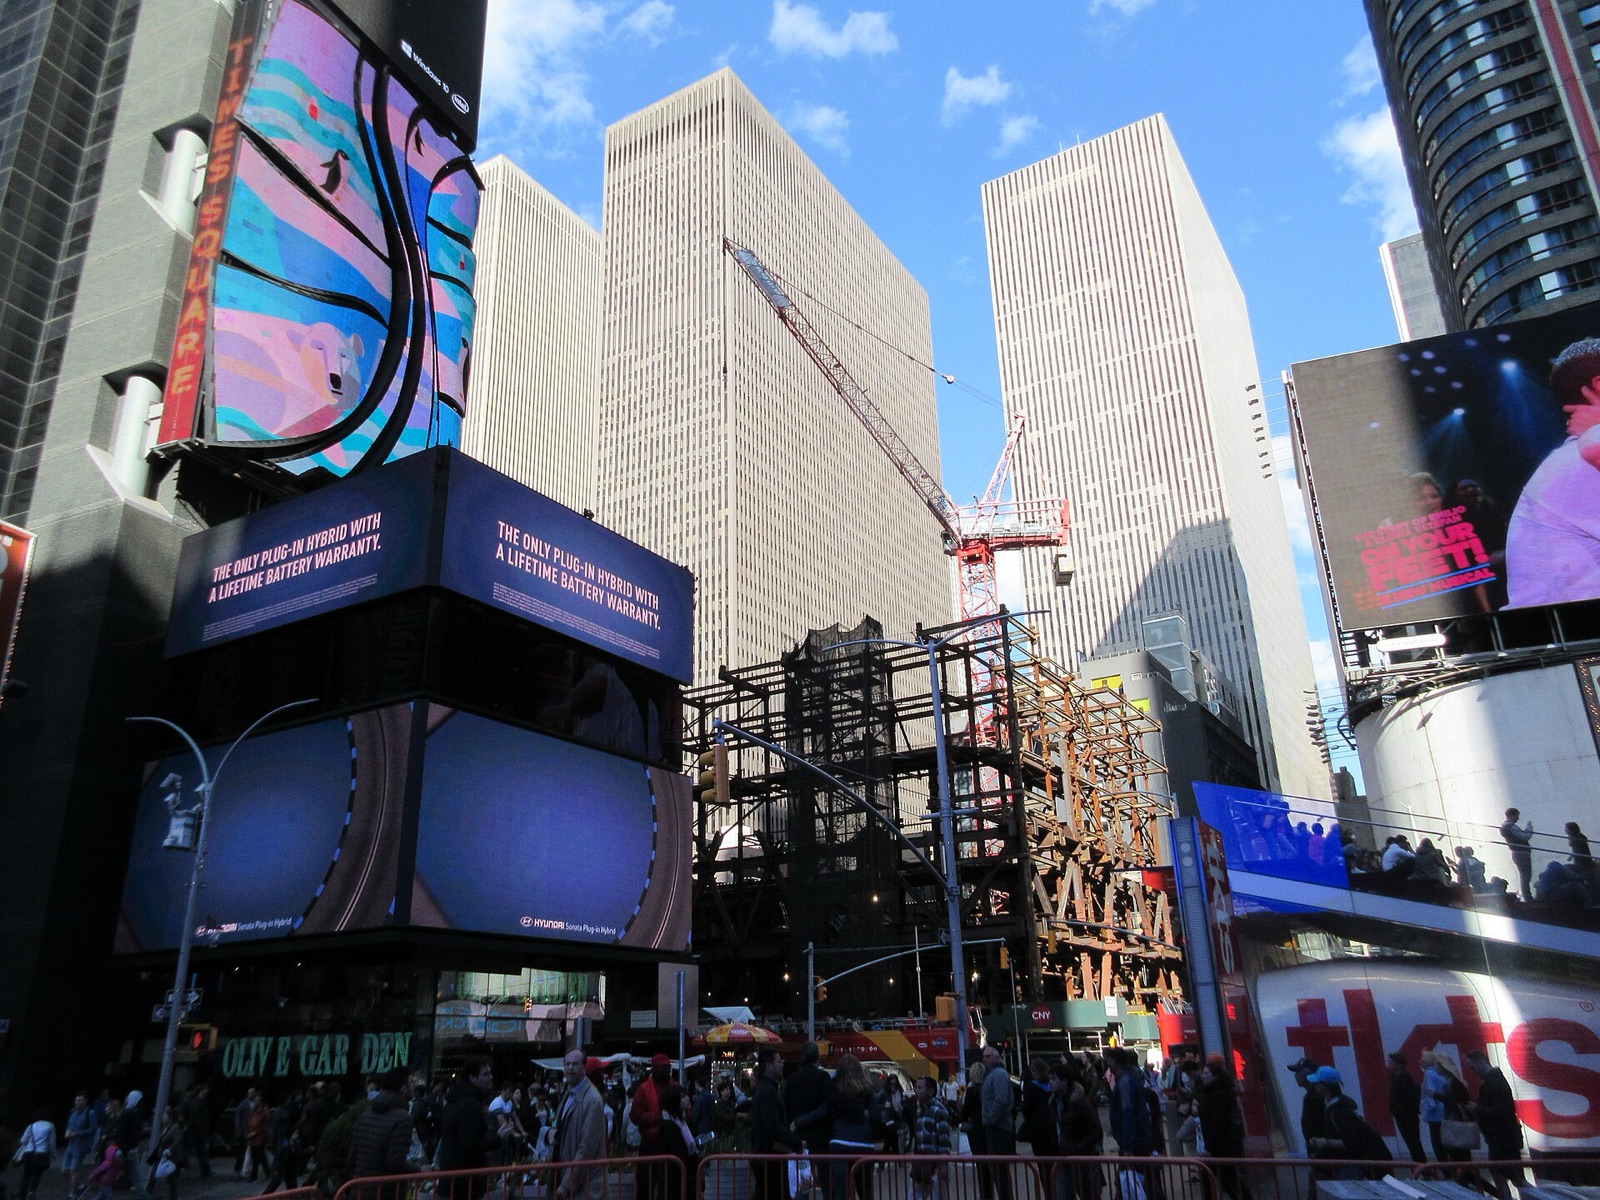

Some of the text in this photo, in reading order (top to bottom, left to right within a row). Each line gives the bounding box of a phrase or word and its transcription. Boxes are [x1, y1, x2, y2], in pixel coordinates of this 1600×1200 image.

[412, 51, 450, 94] Windows 10
[170, 35, 253, 397] TIMES SQUARE
[213, 512, 382, 583] THE ONLY PLUG-IN HYBRID WITH
[498, 520, 659, 611] THE ONLY PLUG-IN HYBRID WITH
[1360, 542, 1401, 566] ON
[1402, 522, 1477, 551] YOUR
[1367, 538, 1490, 591] FEET!
[208, 533, 382, 604] A LIFETIME BATTERY WARRANTY.
[496, 542, 505, 562] A
[507, 547, 558, 585] LIFETIME
[561, 571, 604, 605] BATTERY
[606, 592, 661, 631] WARRANTY.
[274, 917, 293, 929] Hybrid
[534, 918, 617, 936] HYUNDAI Sonata Plug-in Hybrid
[1031, 1010, 1051, 1020] CNY
[222, 1036, 291, 1078] OLIVE
